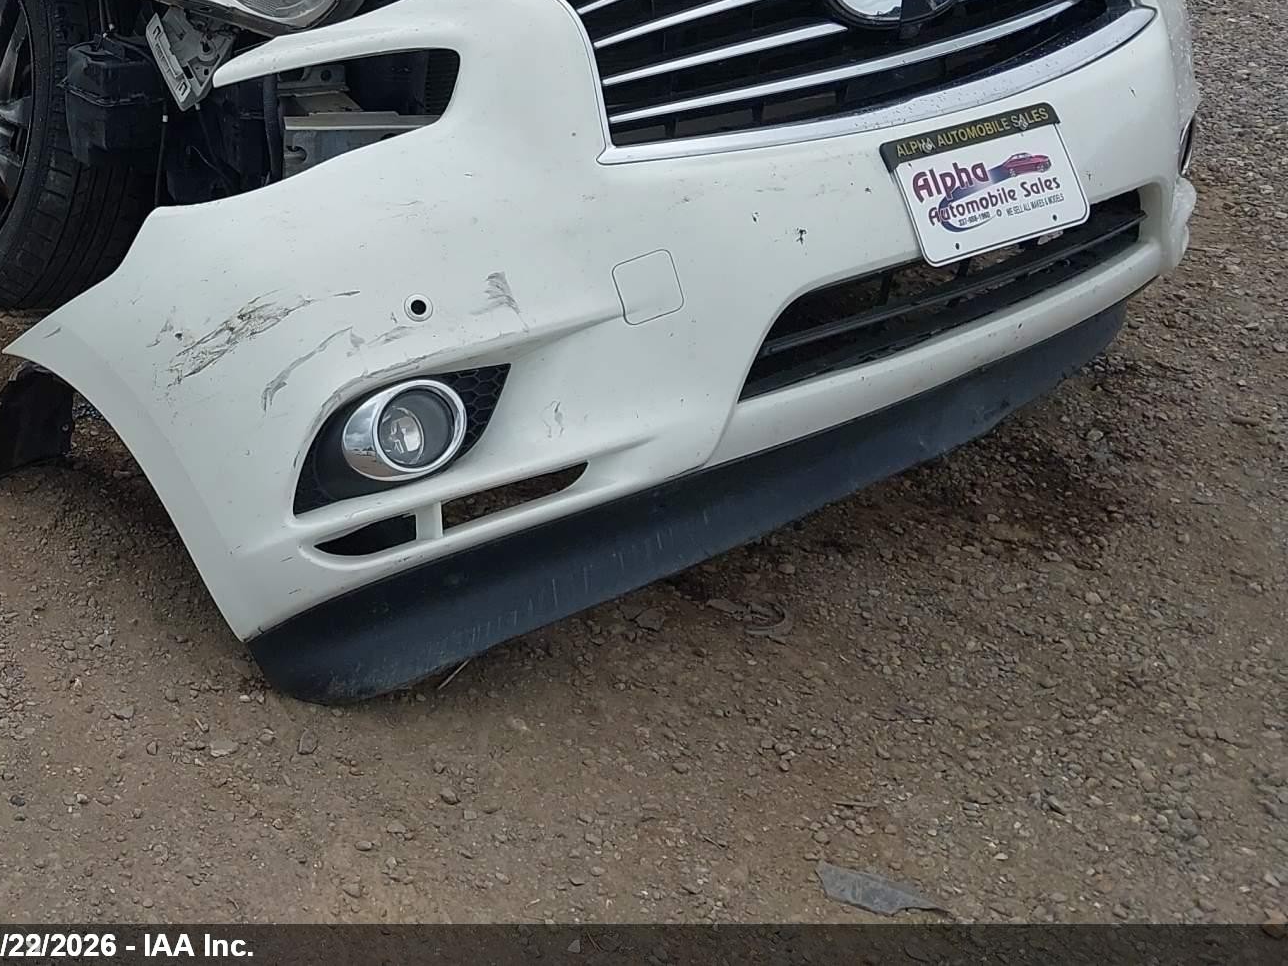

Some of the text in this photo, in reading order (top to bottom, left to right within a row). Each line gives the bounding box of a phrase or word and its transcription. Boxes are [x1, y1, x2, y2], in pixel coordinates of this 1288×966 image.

[896, 107, 1049, 157] ALPHA AUTOMOBILE SALES
[912, 161, 990, 203] Alpha
[928, 175, 1061, 226] Automobile Sales
